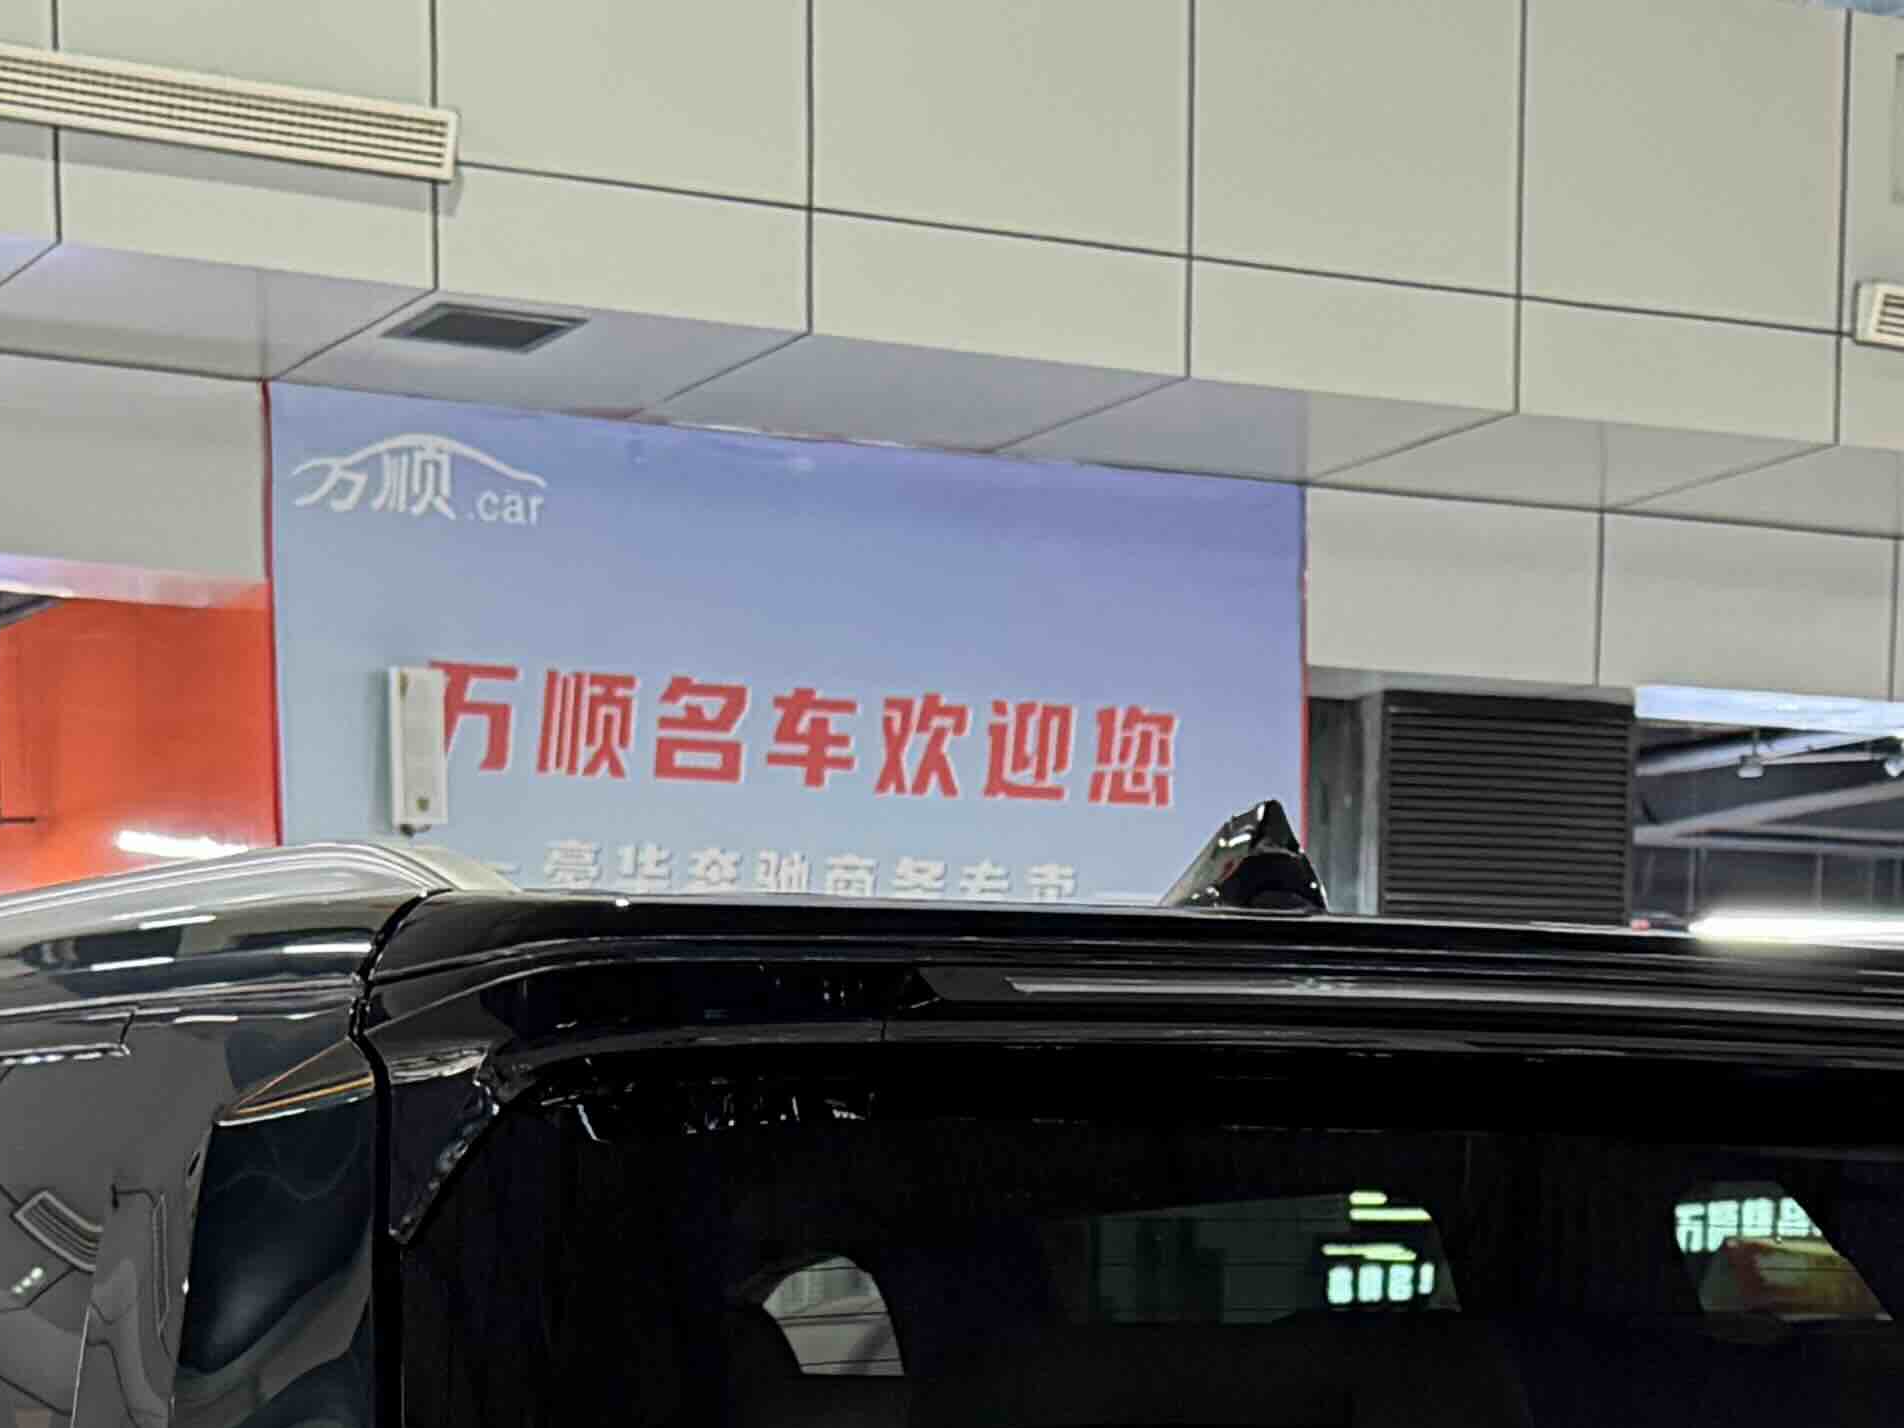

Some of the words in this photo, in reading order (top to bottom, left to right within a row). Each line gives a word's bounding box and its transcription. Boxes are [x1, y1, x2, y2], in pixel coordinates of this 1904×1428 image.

[428, 659, 1178, 808] 万顺名车欢迎您
